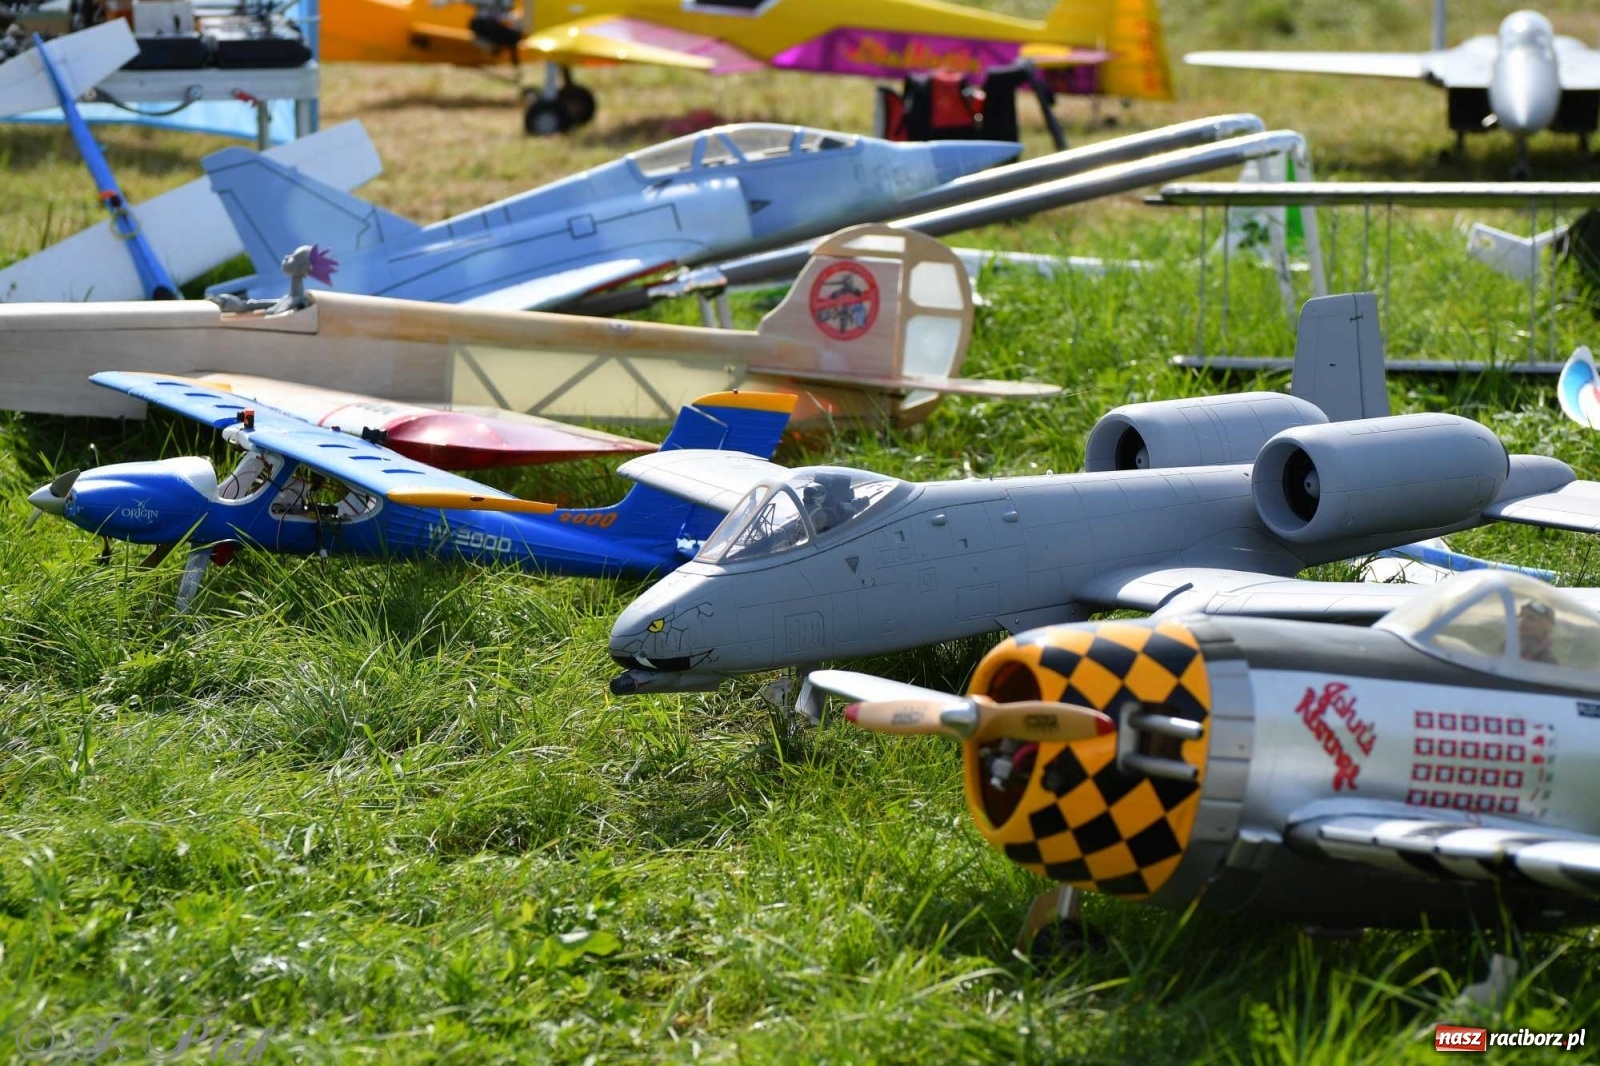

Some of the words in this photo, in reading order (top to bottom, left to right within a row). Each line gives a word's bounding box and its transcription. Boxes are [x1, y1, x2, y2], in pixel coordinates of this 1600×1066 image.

[121, 507, 159, 520] ORIGIN
[558, 511, 619, 529] 2000
[453, 528, 512, 552] 2000
